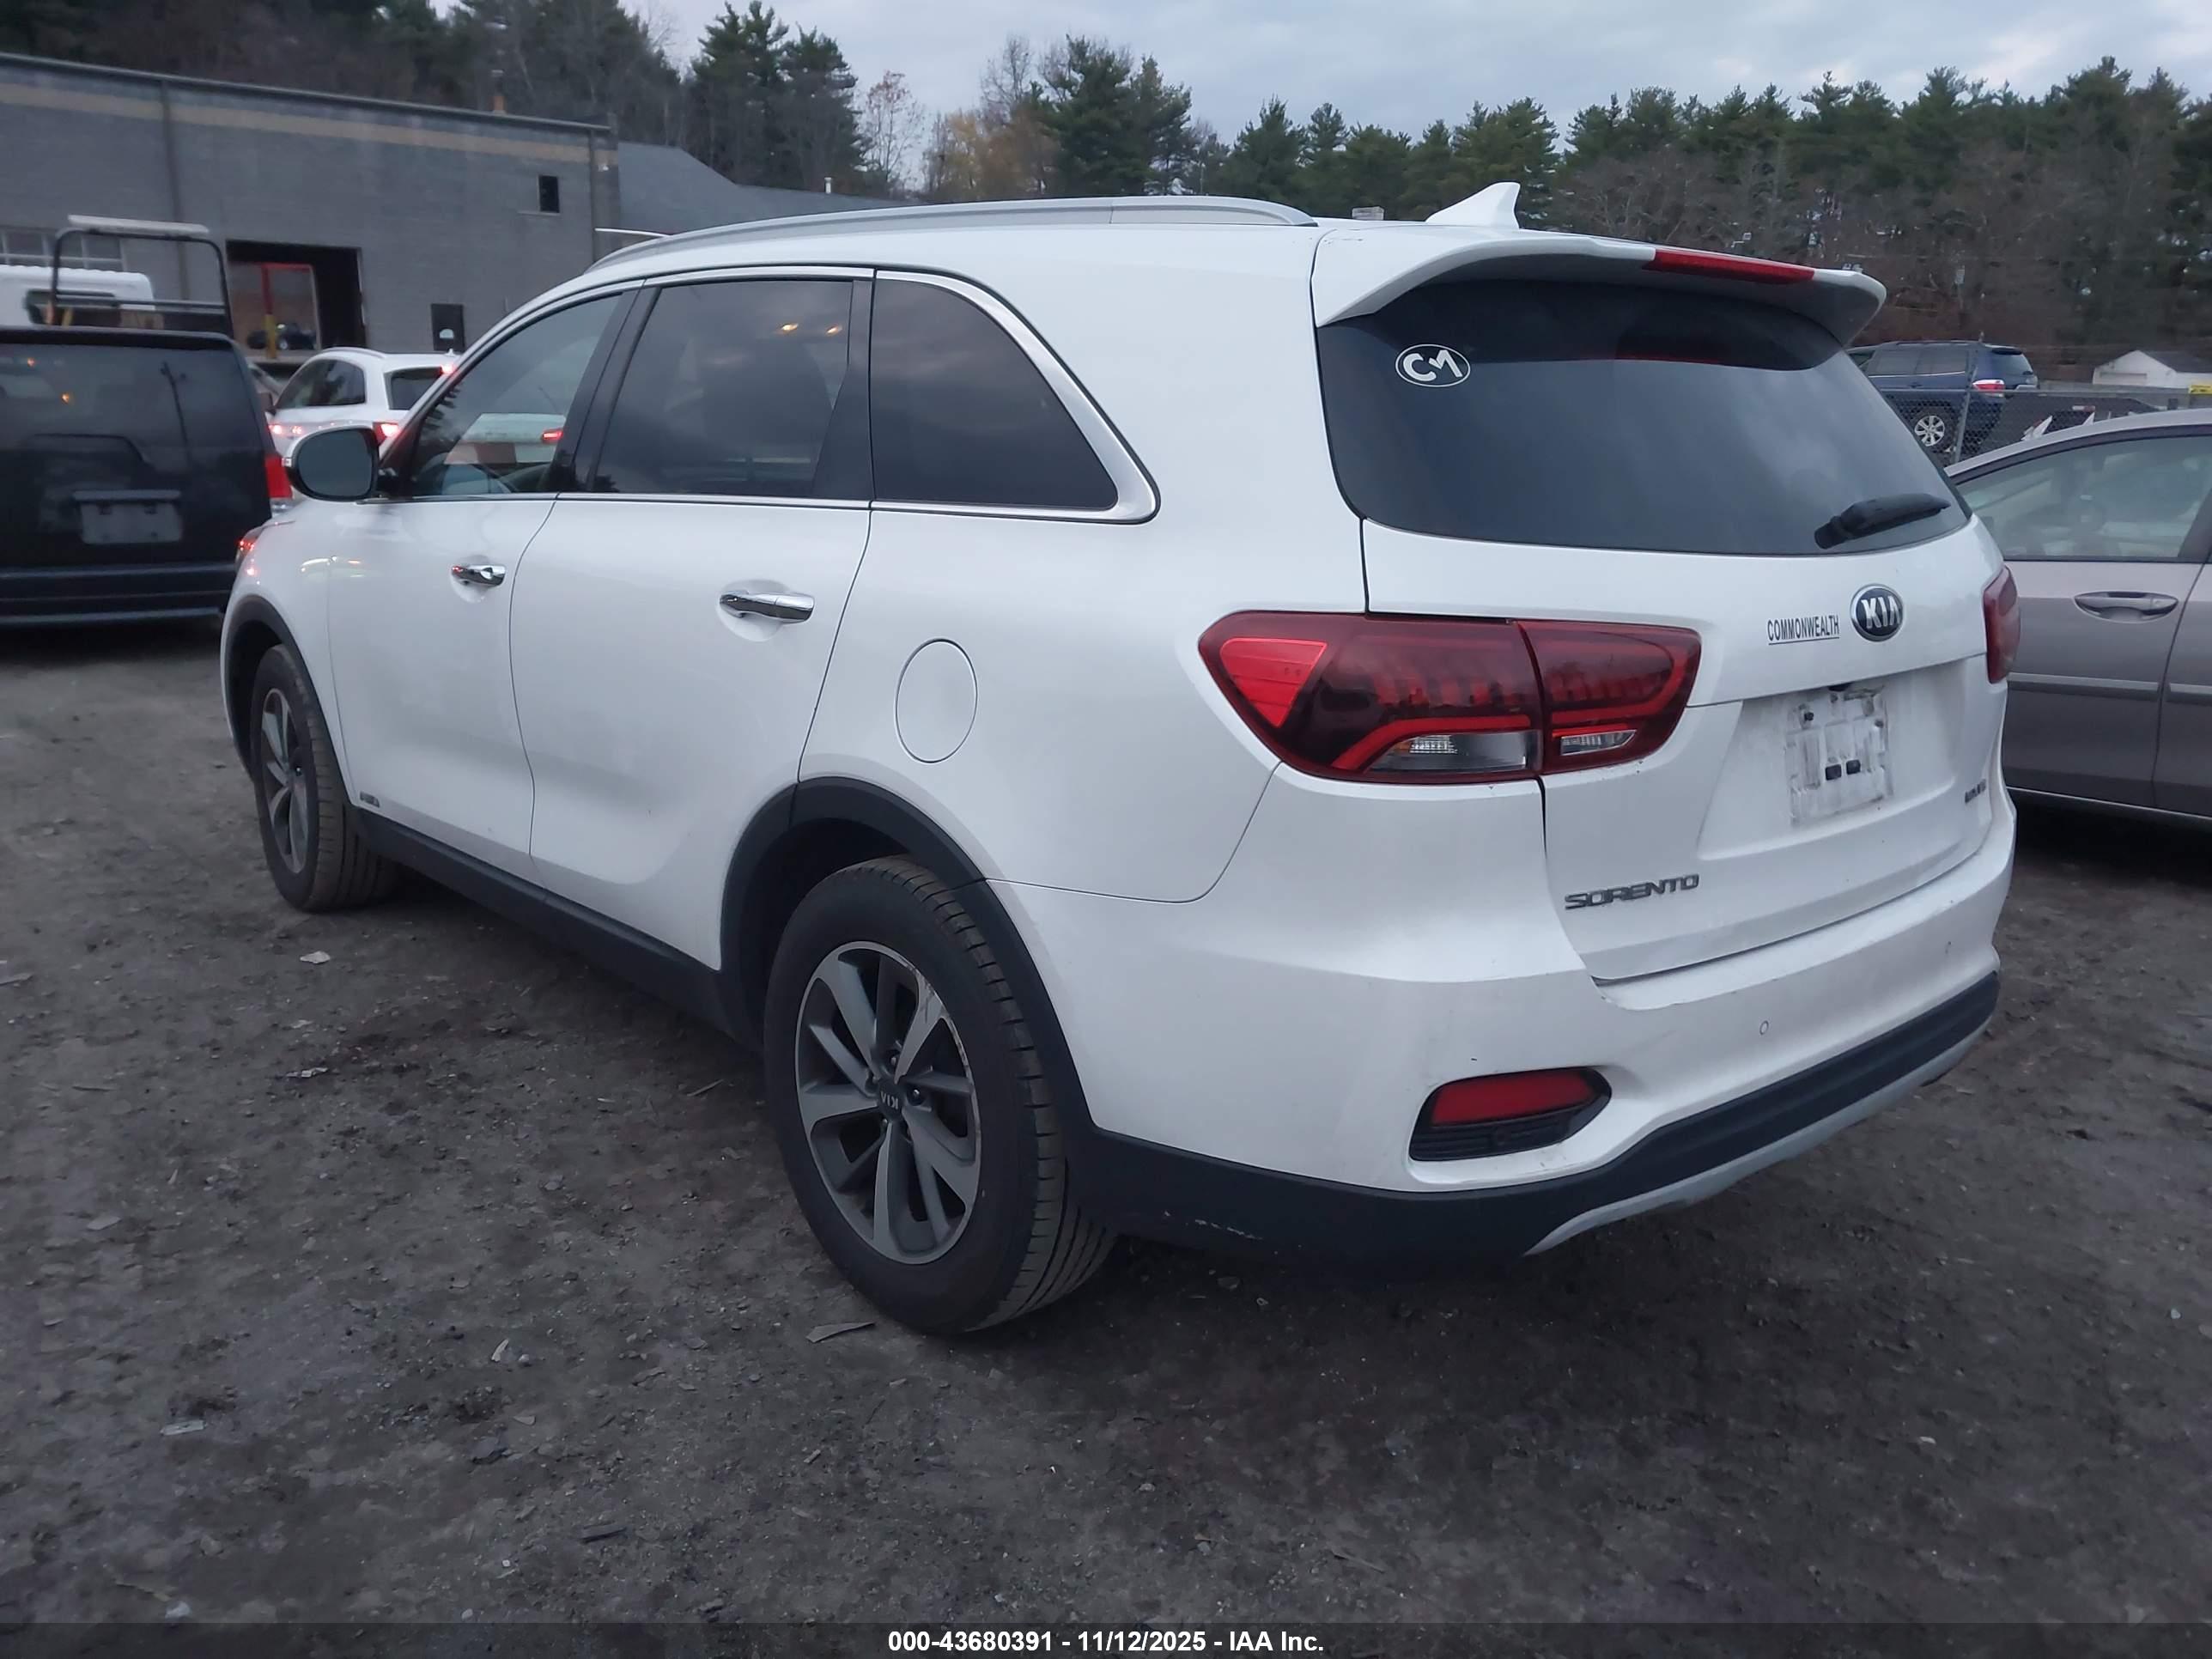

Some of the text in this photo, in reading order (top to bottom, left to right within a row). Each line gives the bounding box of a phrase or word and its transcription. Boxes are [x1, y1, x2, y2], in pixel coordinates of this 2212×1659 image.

[1402, 349, 1462, 382] CM
[1767, 615, 1839, 641] COMMONWEALTH
[1861, 595, 1902, 629] KIA
[1565, 873, 1699, 910] SORENTO
[880, 1091, 899, 1109] KIA
